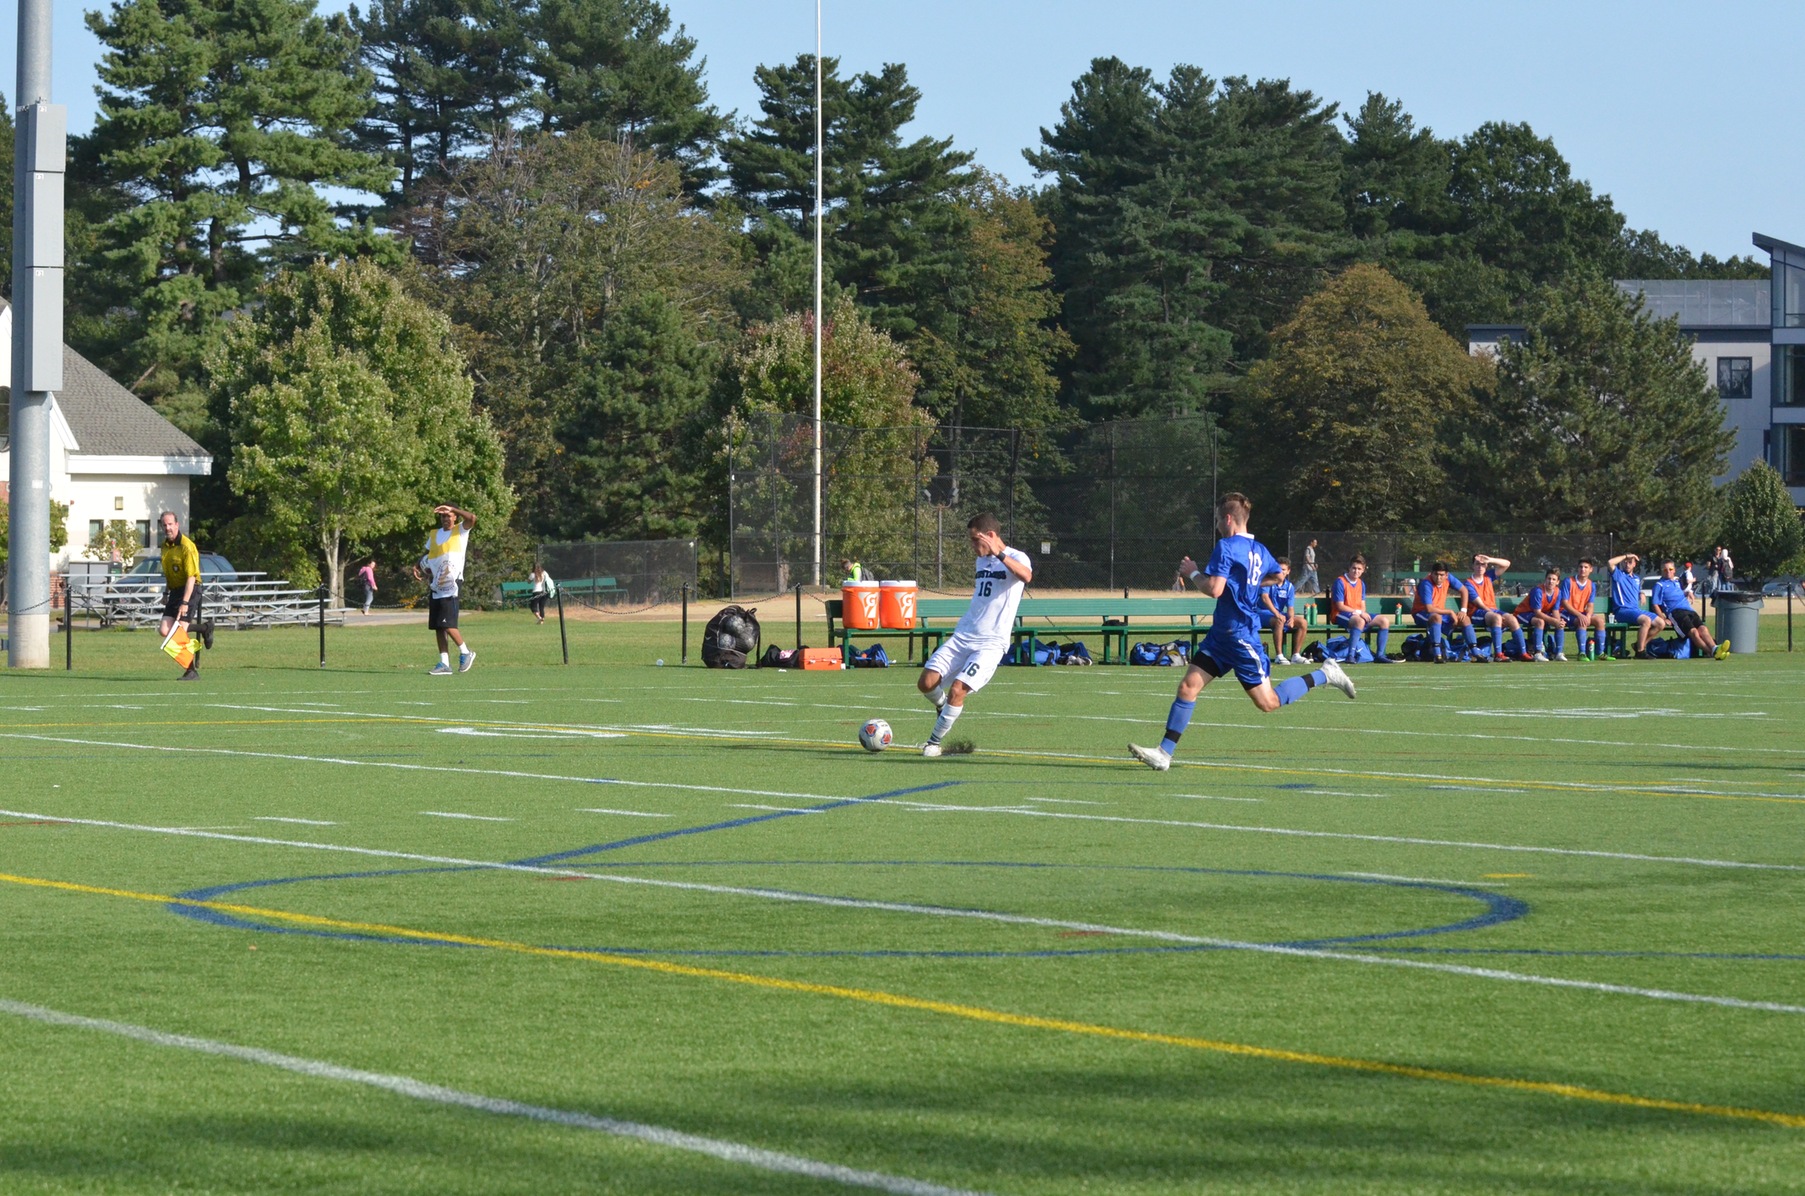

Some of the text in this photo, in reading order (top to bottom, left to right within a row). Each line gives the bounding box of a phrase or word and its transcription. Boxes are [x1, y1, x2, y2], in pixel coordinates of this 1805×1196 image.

[1247, 551, 1262, 586] 18
[978, 581, 993, 597] 16
[962, 661, 980, 677] 16
